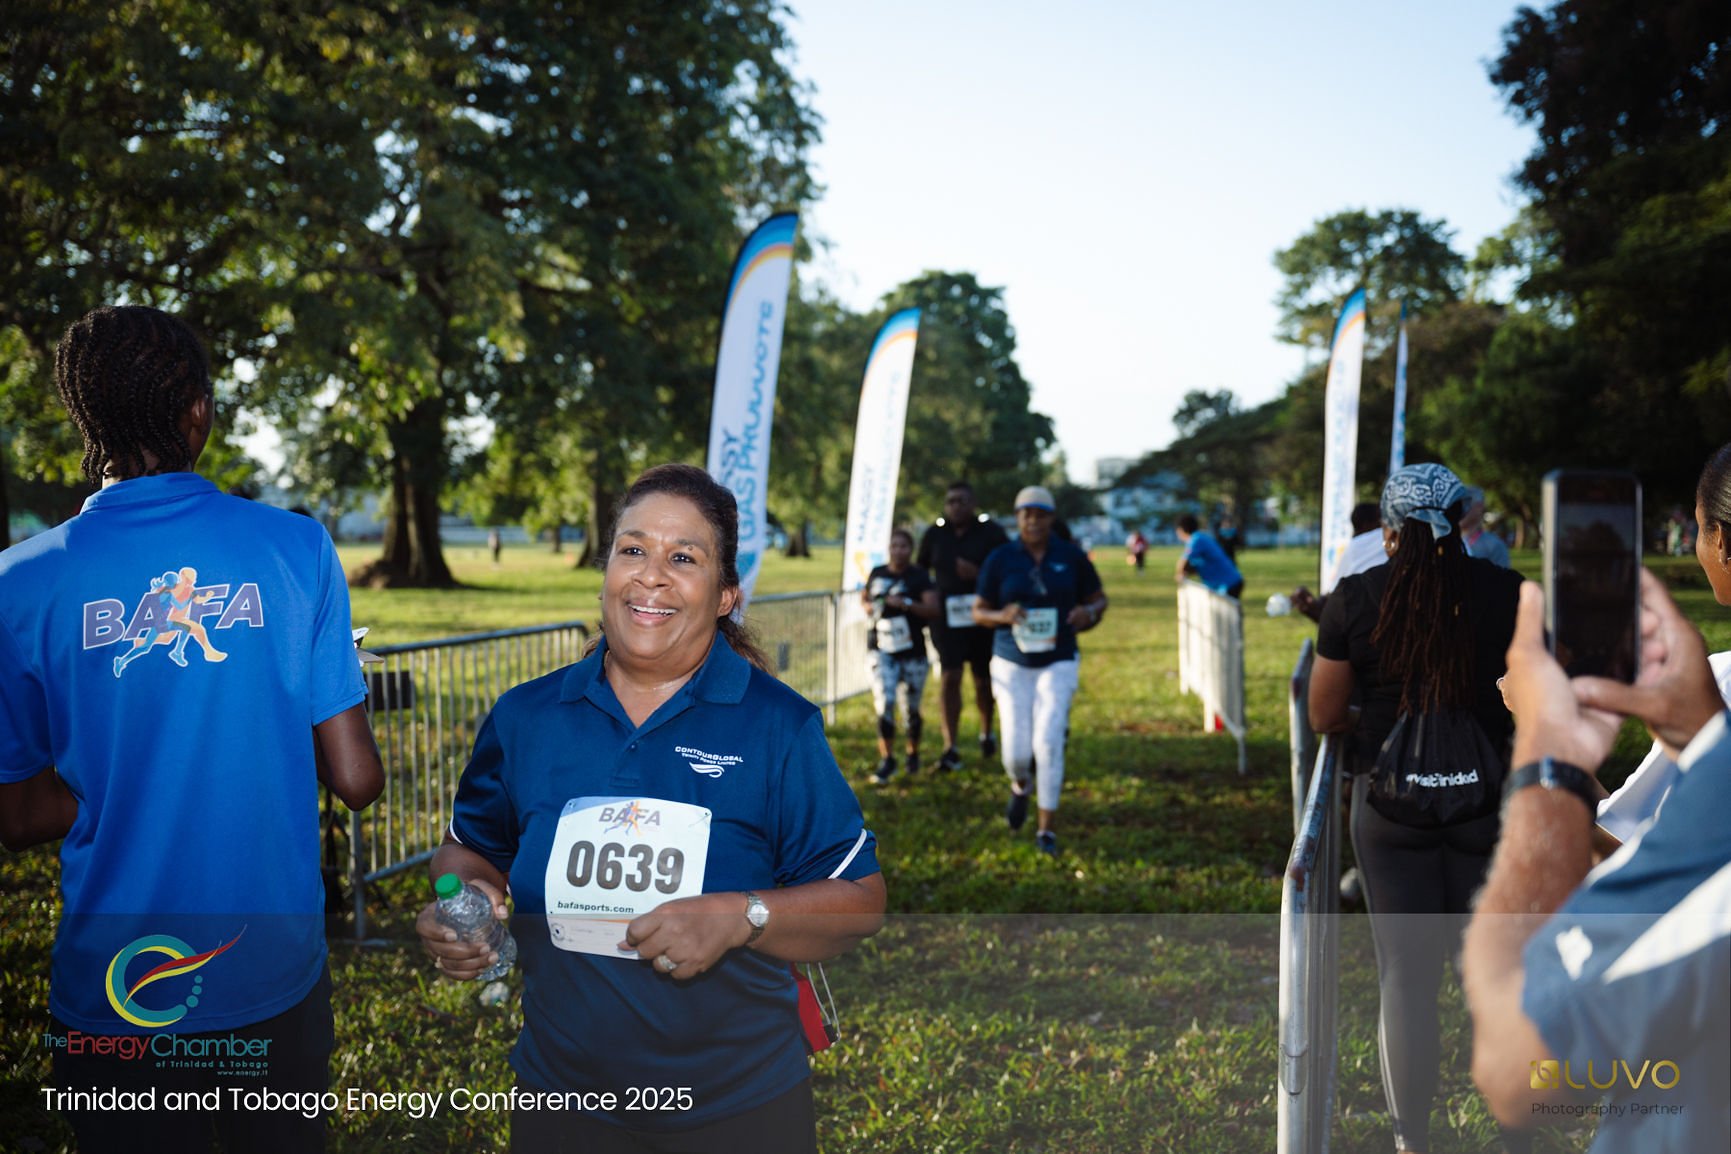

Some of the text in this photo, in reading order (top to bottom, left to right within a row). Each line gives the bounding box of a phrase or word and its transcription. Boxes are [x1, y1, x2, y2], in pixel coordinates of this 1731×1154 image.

[83, 583, 264, 650] BAFA
[598, 807, 661, 826] BAFA
[566, 840, 685, 895] 0639
[557, 901, 634, 914] bafasports.com
